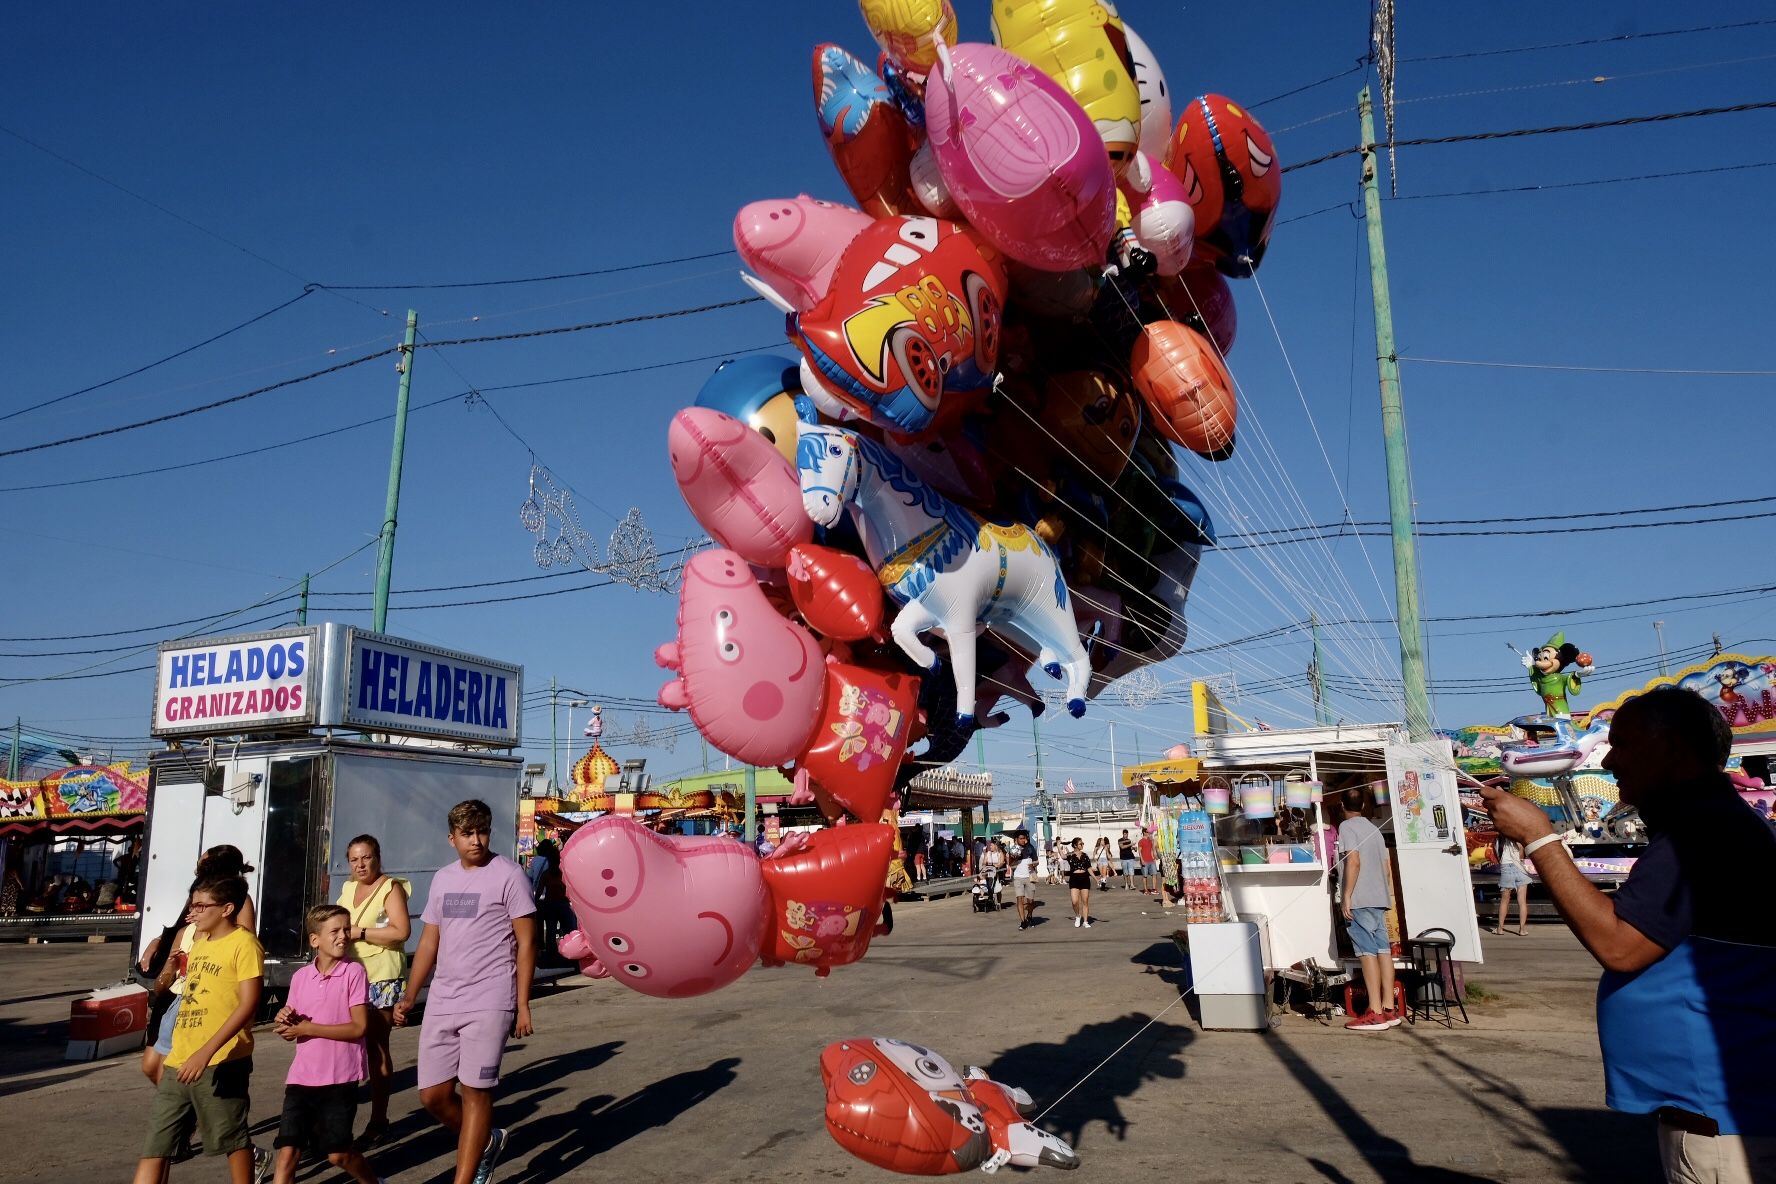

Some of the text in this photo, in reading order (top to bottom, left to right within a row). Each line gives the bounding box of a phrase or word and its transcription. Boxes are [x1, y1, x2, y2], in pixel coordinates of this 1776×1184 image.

[169, 641, 304, 688] HELADOS
[165, 684, 303, 721] GRANIZADOS
[359, 648, 507, 728] HELADERIA
[201, 961, 222, 977] PARK
